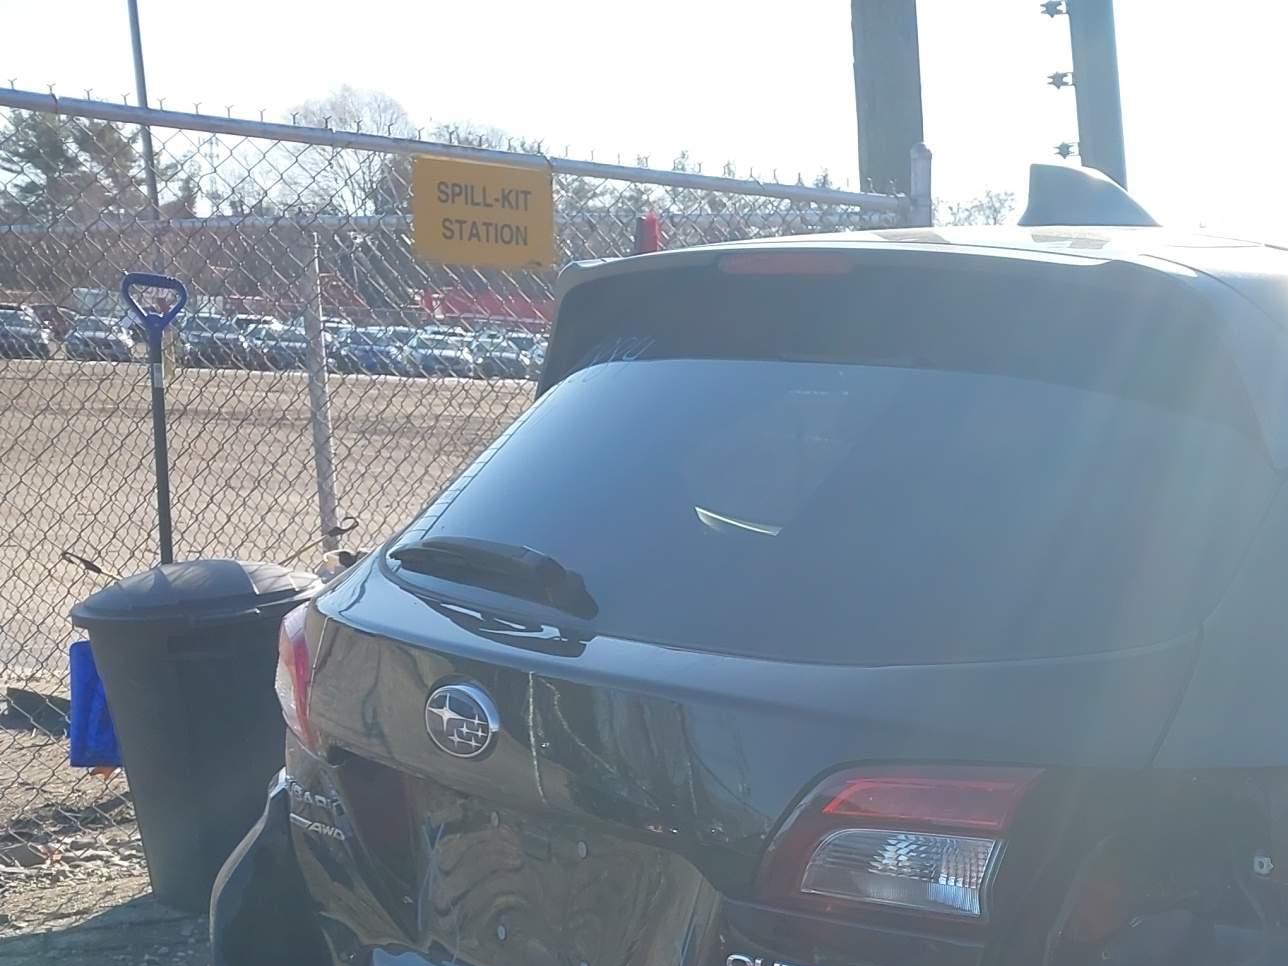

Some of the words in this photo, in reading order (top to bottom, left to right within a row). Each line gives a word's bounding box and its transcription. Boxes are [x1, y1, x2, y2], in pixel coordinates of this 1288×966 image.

[437, 181, 532, 212] SPILL-KIT
[441, 217, 529, 246] STATION
[308, 822, 345, 841] AWD
